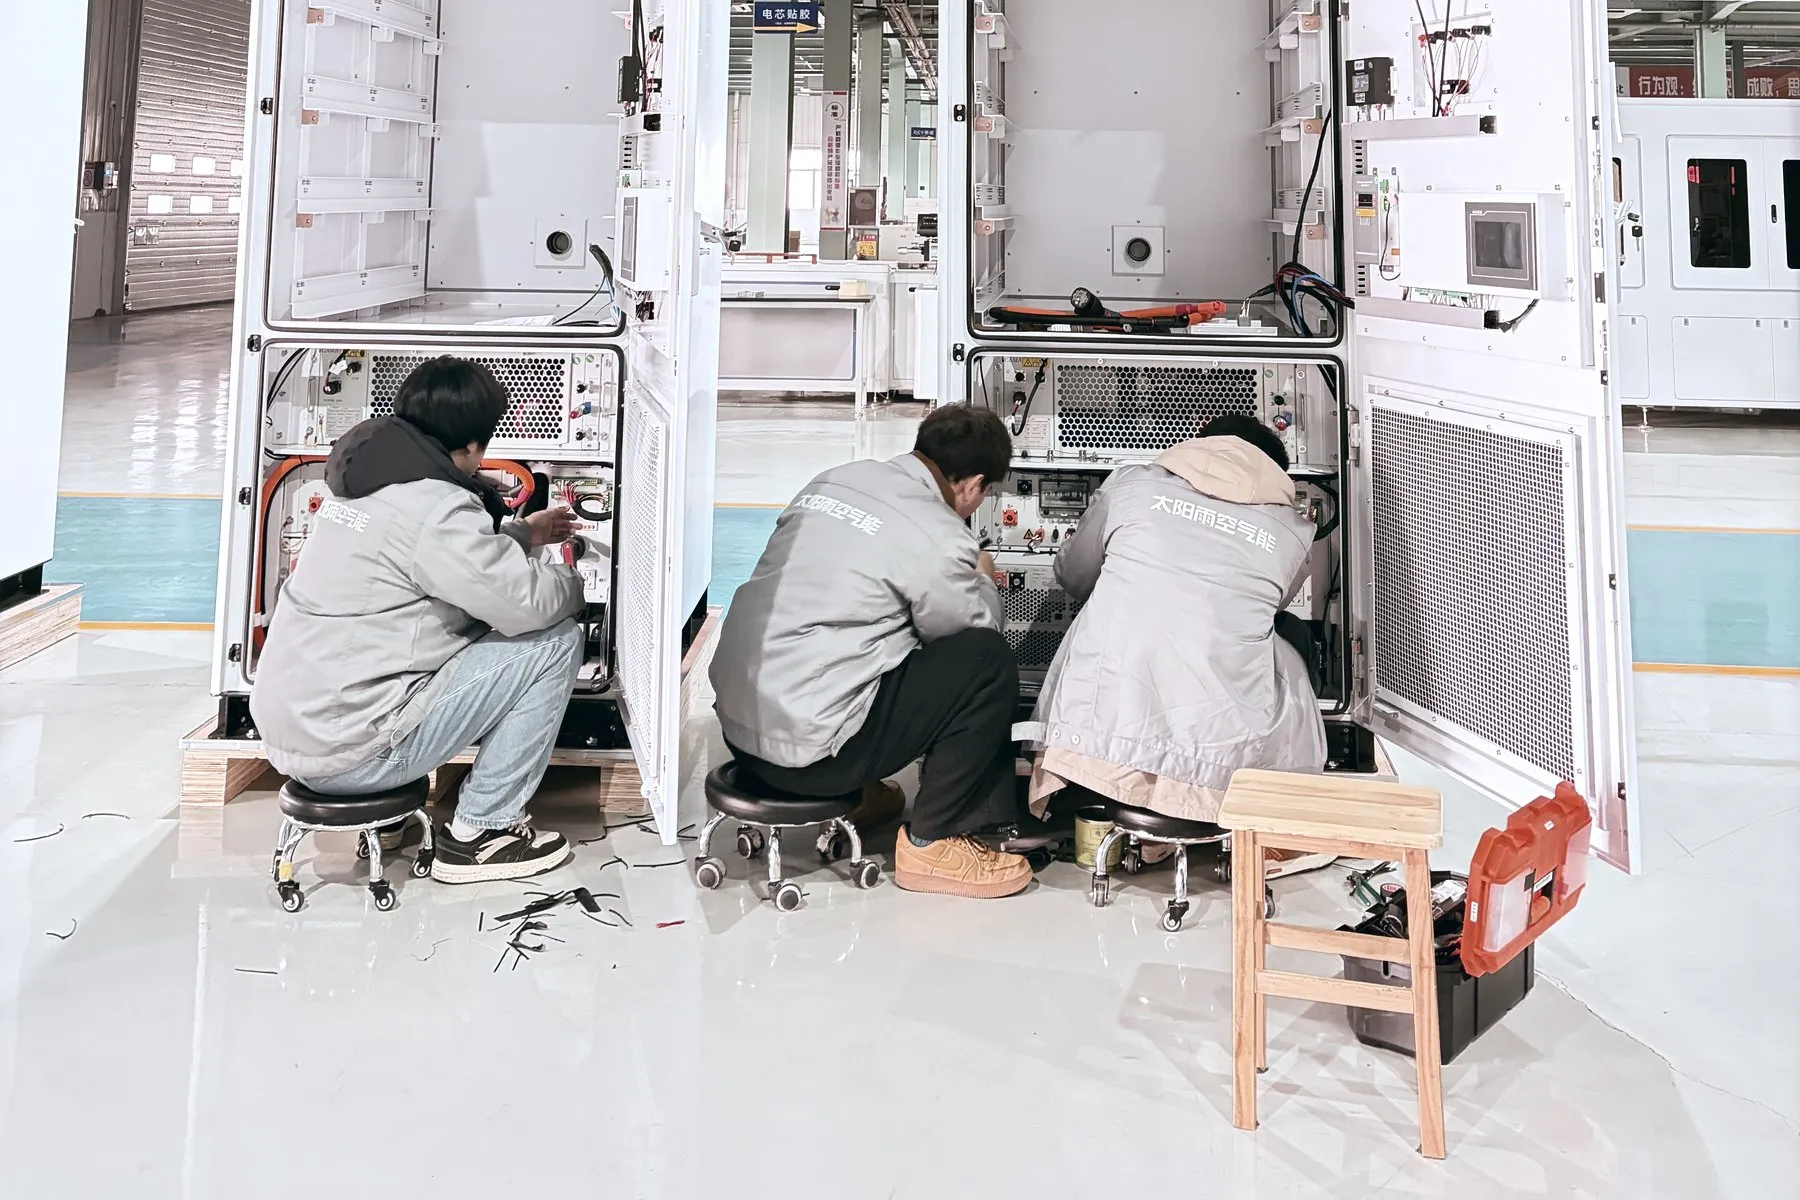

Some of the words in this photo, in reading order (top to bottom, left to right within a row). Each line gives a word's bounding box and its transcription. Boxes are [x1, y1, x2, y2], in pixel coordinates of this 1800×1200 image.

[762, 8, 811, 20] 电芯贴胶
[794, 493, 885, 536] 太阳雨空气能
[1150, 495, 1277, 554] 太阳雨空气能
